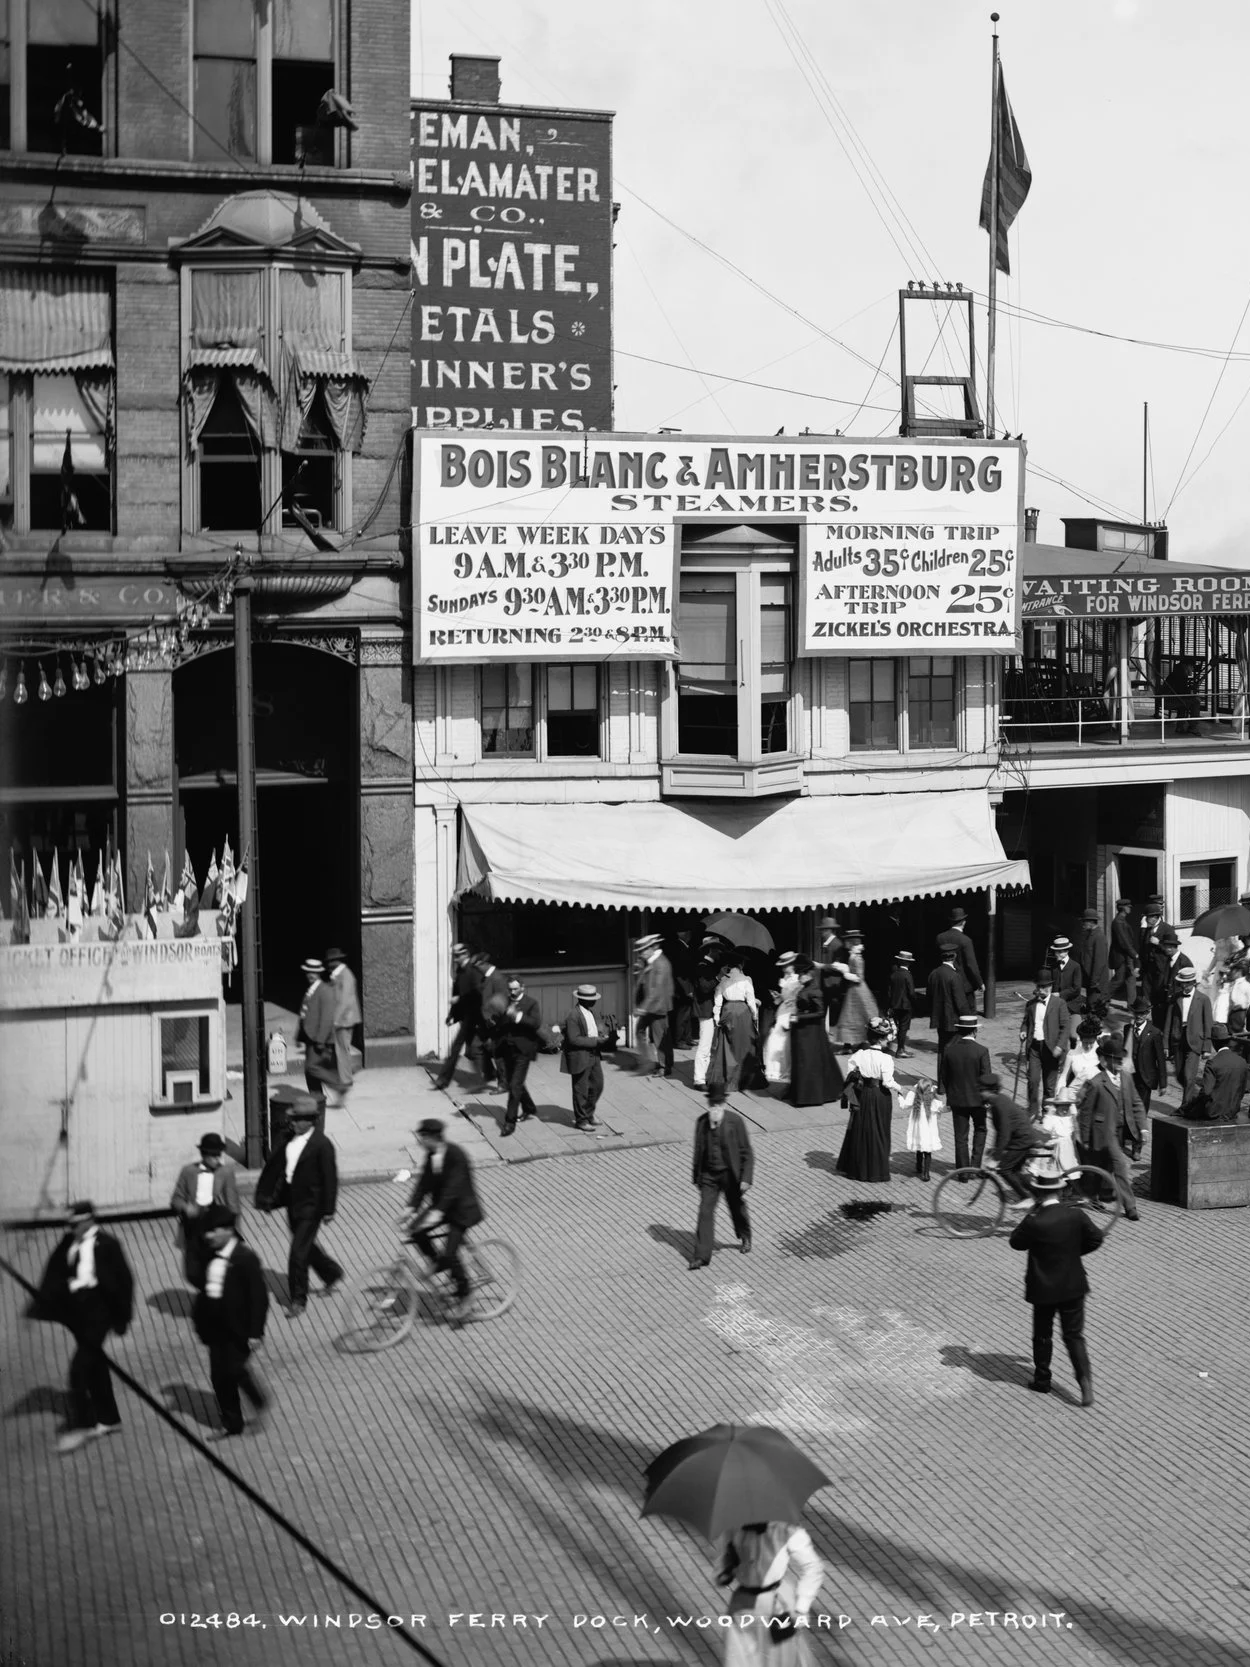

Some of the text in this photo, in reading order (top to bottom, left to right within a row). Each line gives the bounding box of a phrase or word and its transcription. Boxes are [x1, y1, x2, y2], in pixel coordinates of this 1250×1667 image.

[410, 111, 534, 156] EMAN,
[410, 158, 600, 202] ELAMATER
[420, 202, 443, 219] &
[443, 237, 599, 301] PLATE,
[411, 305, 556, 344] ETALS
[411, 359, 592, 391] INNER'S
[440, 444, 1002, 494] BOIS BLANC & AMHERSTBURG
[611, 494, 858, 513] STEAMERS.
[429, 526, 666, 545] LEAVE WEEK DAYS
[826, 525, 1000, 541] MORNING TRIP
[595, 552, 649, 577] P.M.
[812, 547, 862, 573] Adults
[911, 549, 969, 573] Children
[427, 590, 498, 614] SUNDAYS
[814, 584, 941, 600] AFTERNOON
[1087, 595, 1119, 613] FOR
[1128, 593, 1204, 612] WINDSOR
[844, 601, 907, 615] TRIP
[1021, 595, 1064, 612] NTRANCE
[429, 627, 562, 646] RETURNING
[811, 619, 892, 638] ZICKEL'S
[59, 947, 112, 968] OFFICE
[132, 942, 193, 964] WINDSOR
